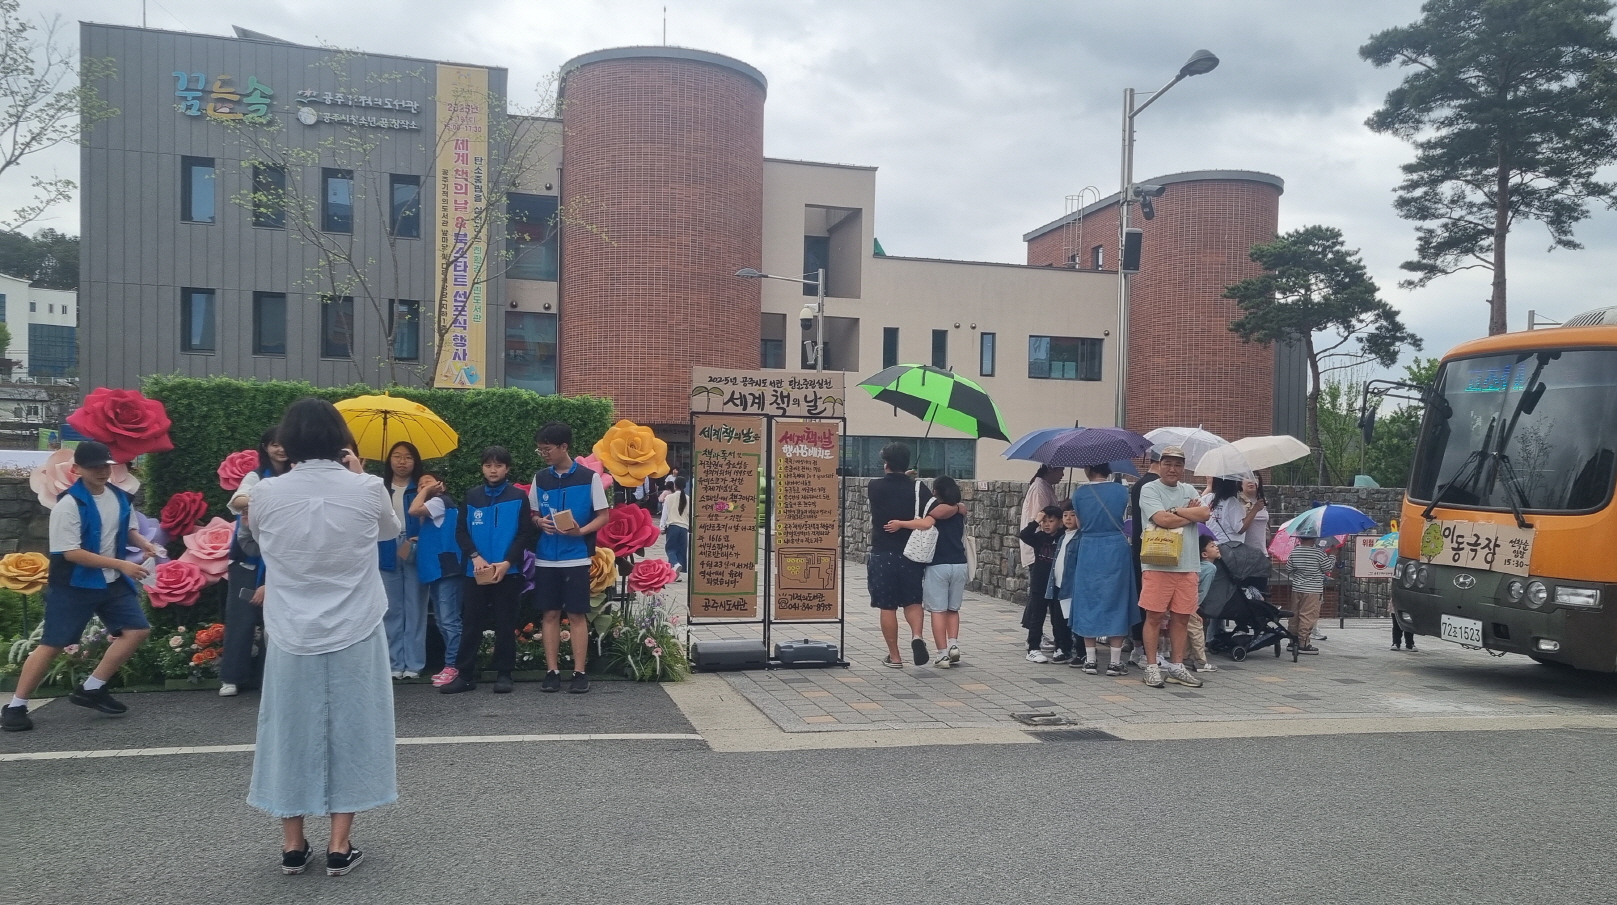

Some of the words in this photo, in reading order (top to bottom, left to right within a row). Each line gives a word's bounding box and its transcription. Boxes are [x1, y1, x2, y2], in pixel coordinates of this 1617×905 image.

[454, 138, 469, 166] 세계
[454, 168, 469, 196] 책의
[454, 199, 470, 212] 날
[452, 333, 468, 361] 행사
[707, 375, 739, 386] 2025년
[723, 390, 766, 412] 세계
[803, 390, 827, 416] 날
[781, 444, 835, 460] 행사장배치도
[1362, 538, 1374, 547] 위험
[1442, 525, 1501, 564] 이동극장
[701, 597, 749, 612] 공주시도서관
[787, 602, 833, 612] 041-840-8955
[1441, 622, 1481, 642] 72조1523
